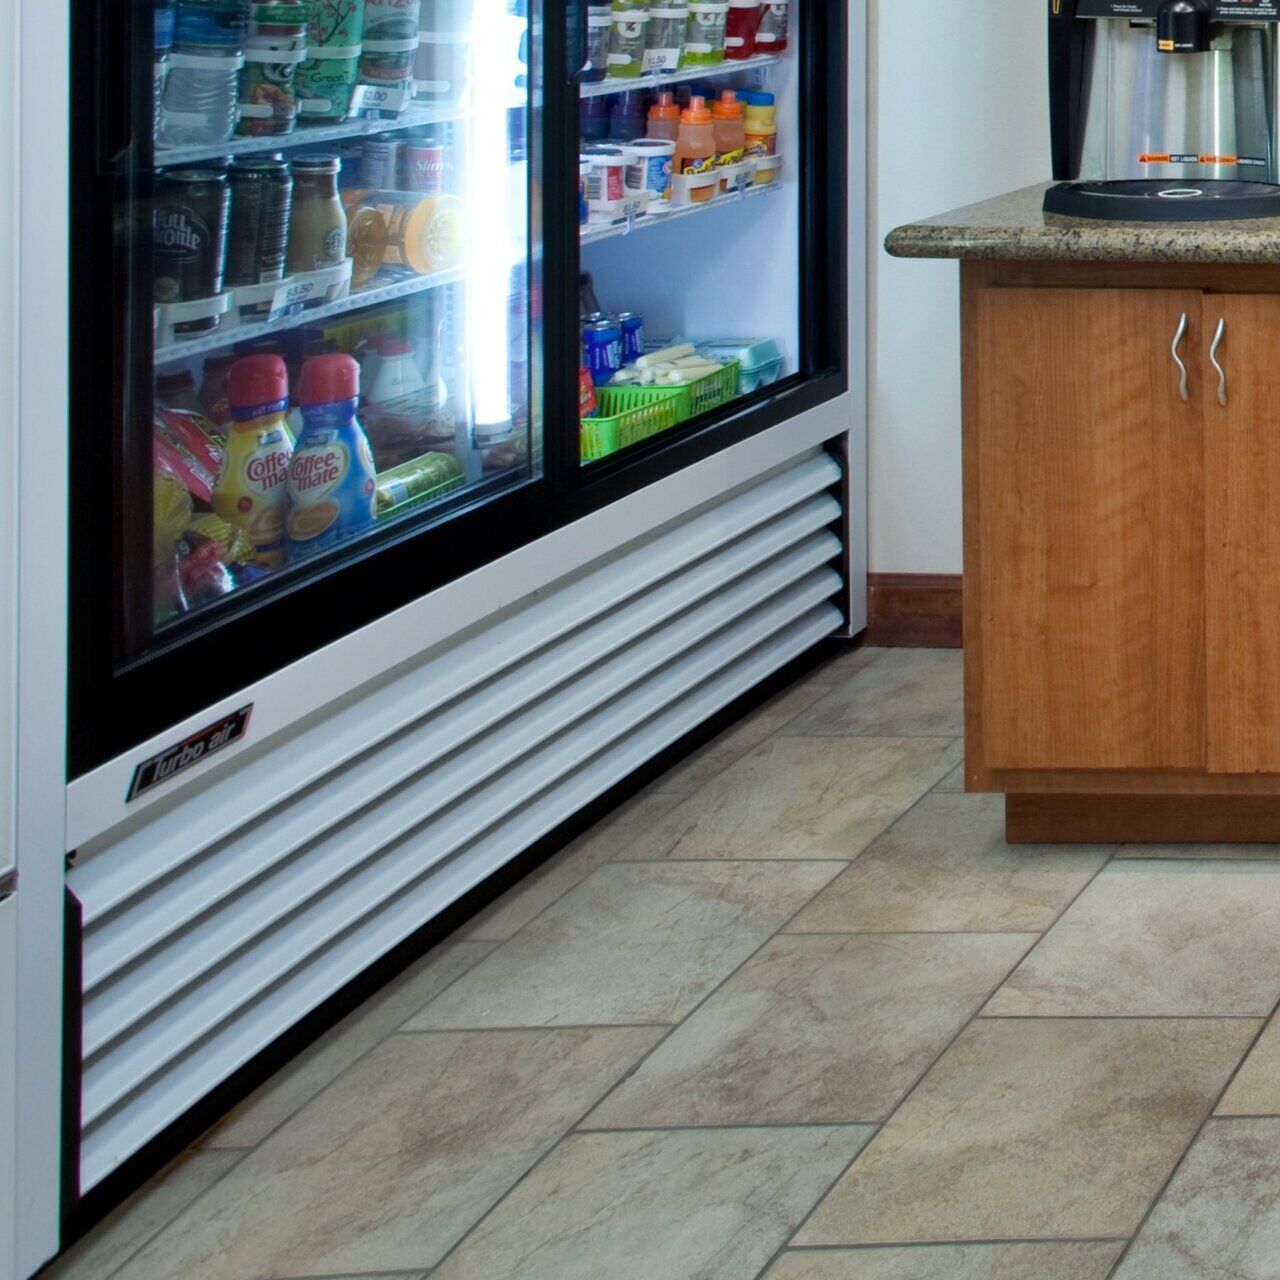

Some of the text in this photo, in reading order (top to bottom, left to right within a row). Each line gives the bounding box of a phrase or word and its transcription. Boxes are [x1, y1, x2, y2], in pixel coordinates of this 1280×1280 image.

[300, 465, 341, 491] mate
[151, 720, 236, 781] Turbo air
